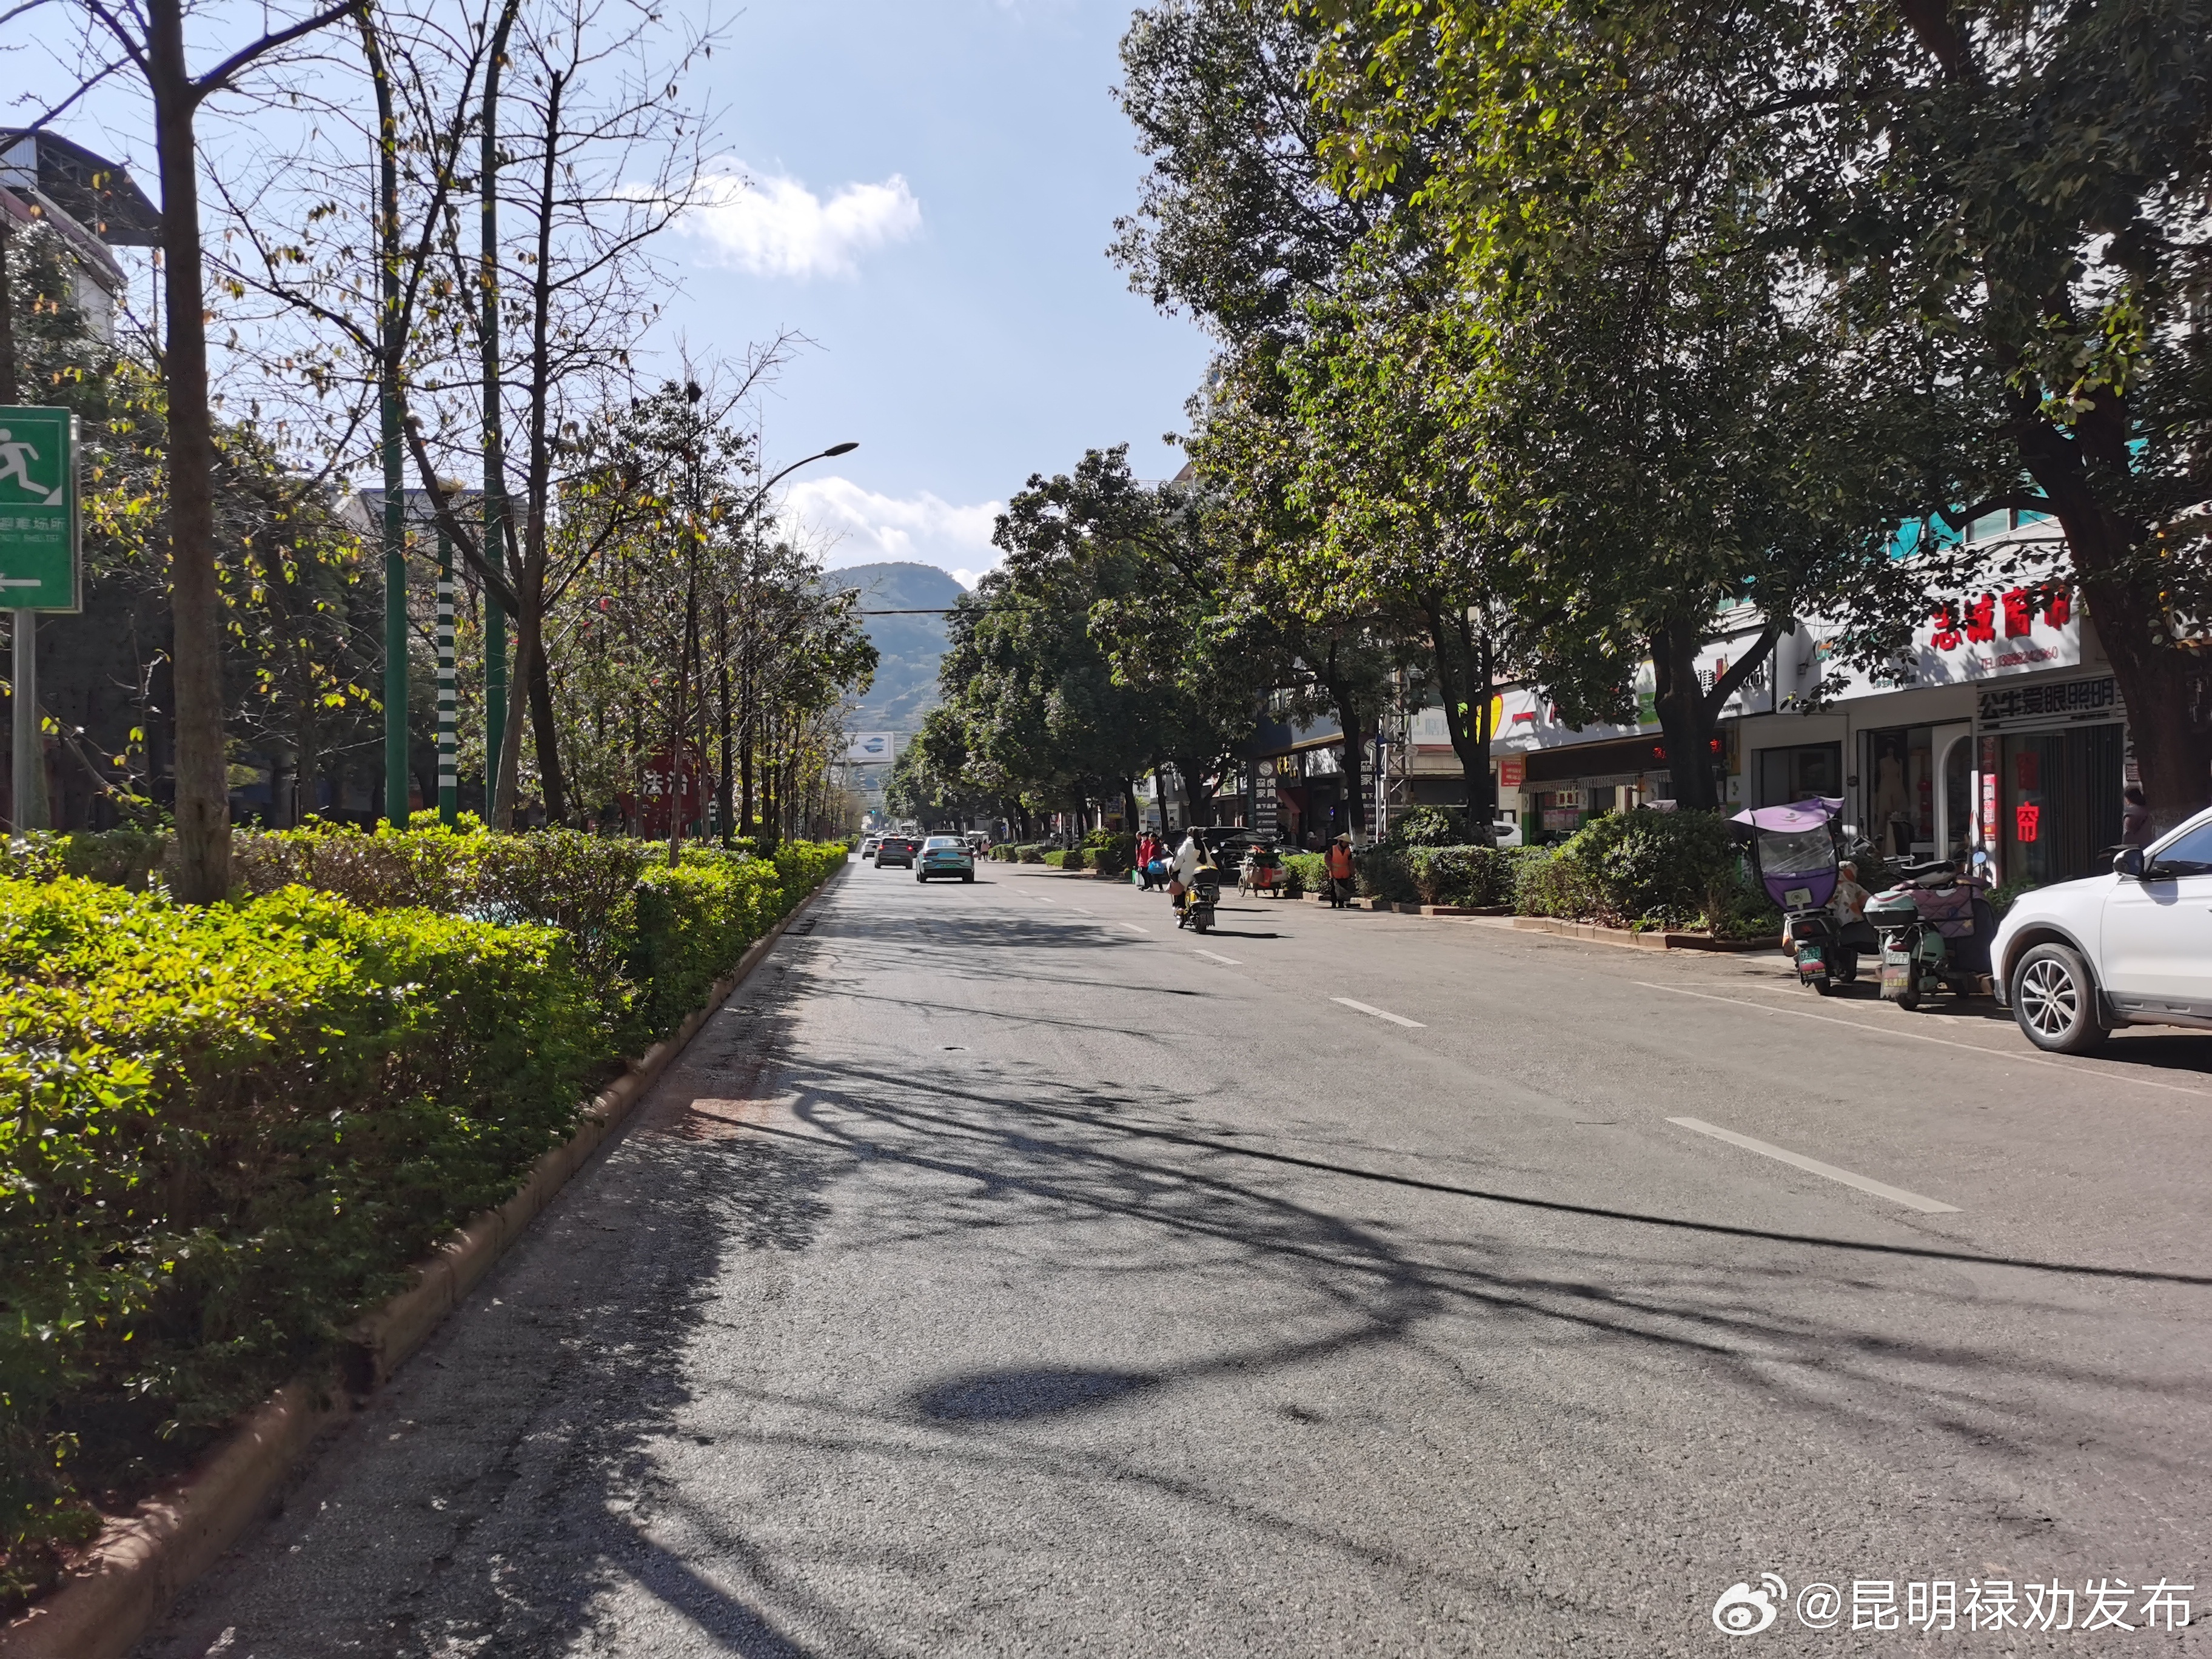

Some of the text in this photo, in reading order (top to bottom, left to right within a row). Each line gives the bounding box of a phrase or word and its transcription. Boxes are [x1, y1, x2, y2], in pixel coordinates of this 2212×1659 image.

[1980, 677, 2114, 720] 公牛爱眼照明
